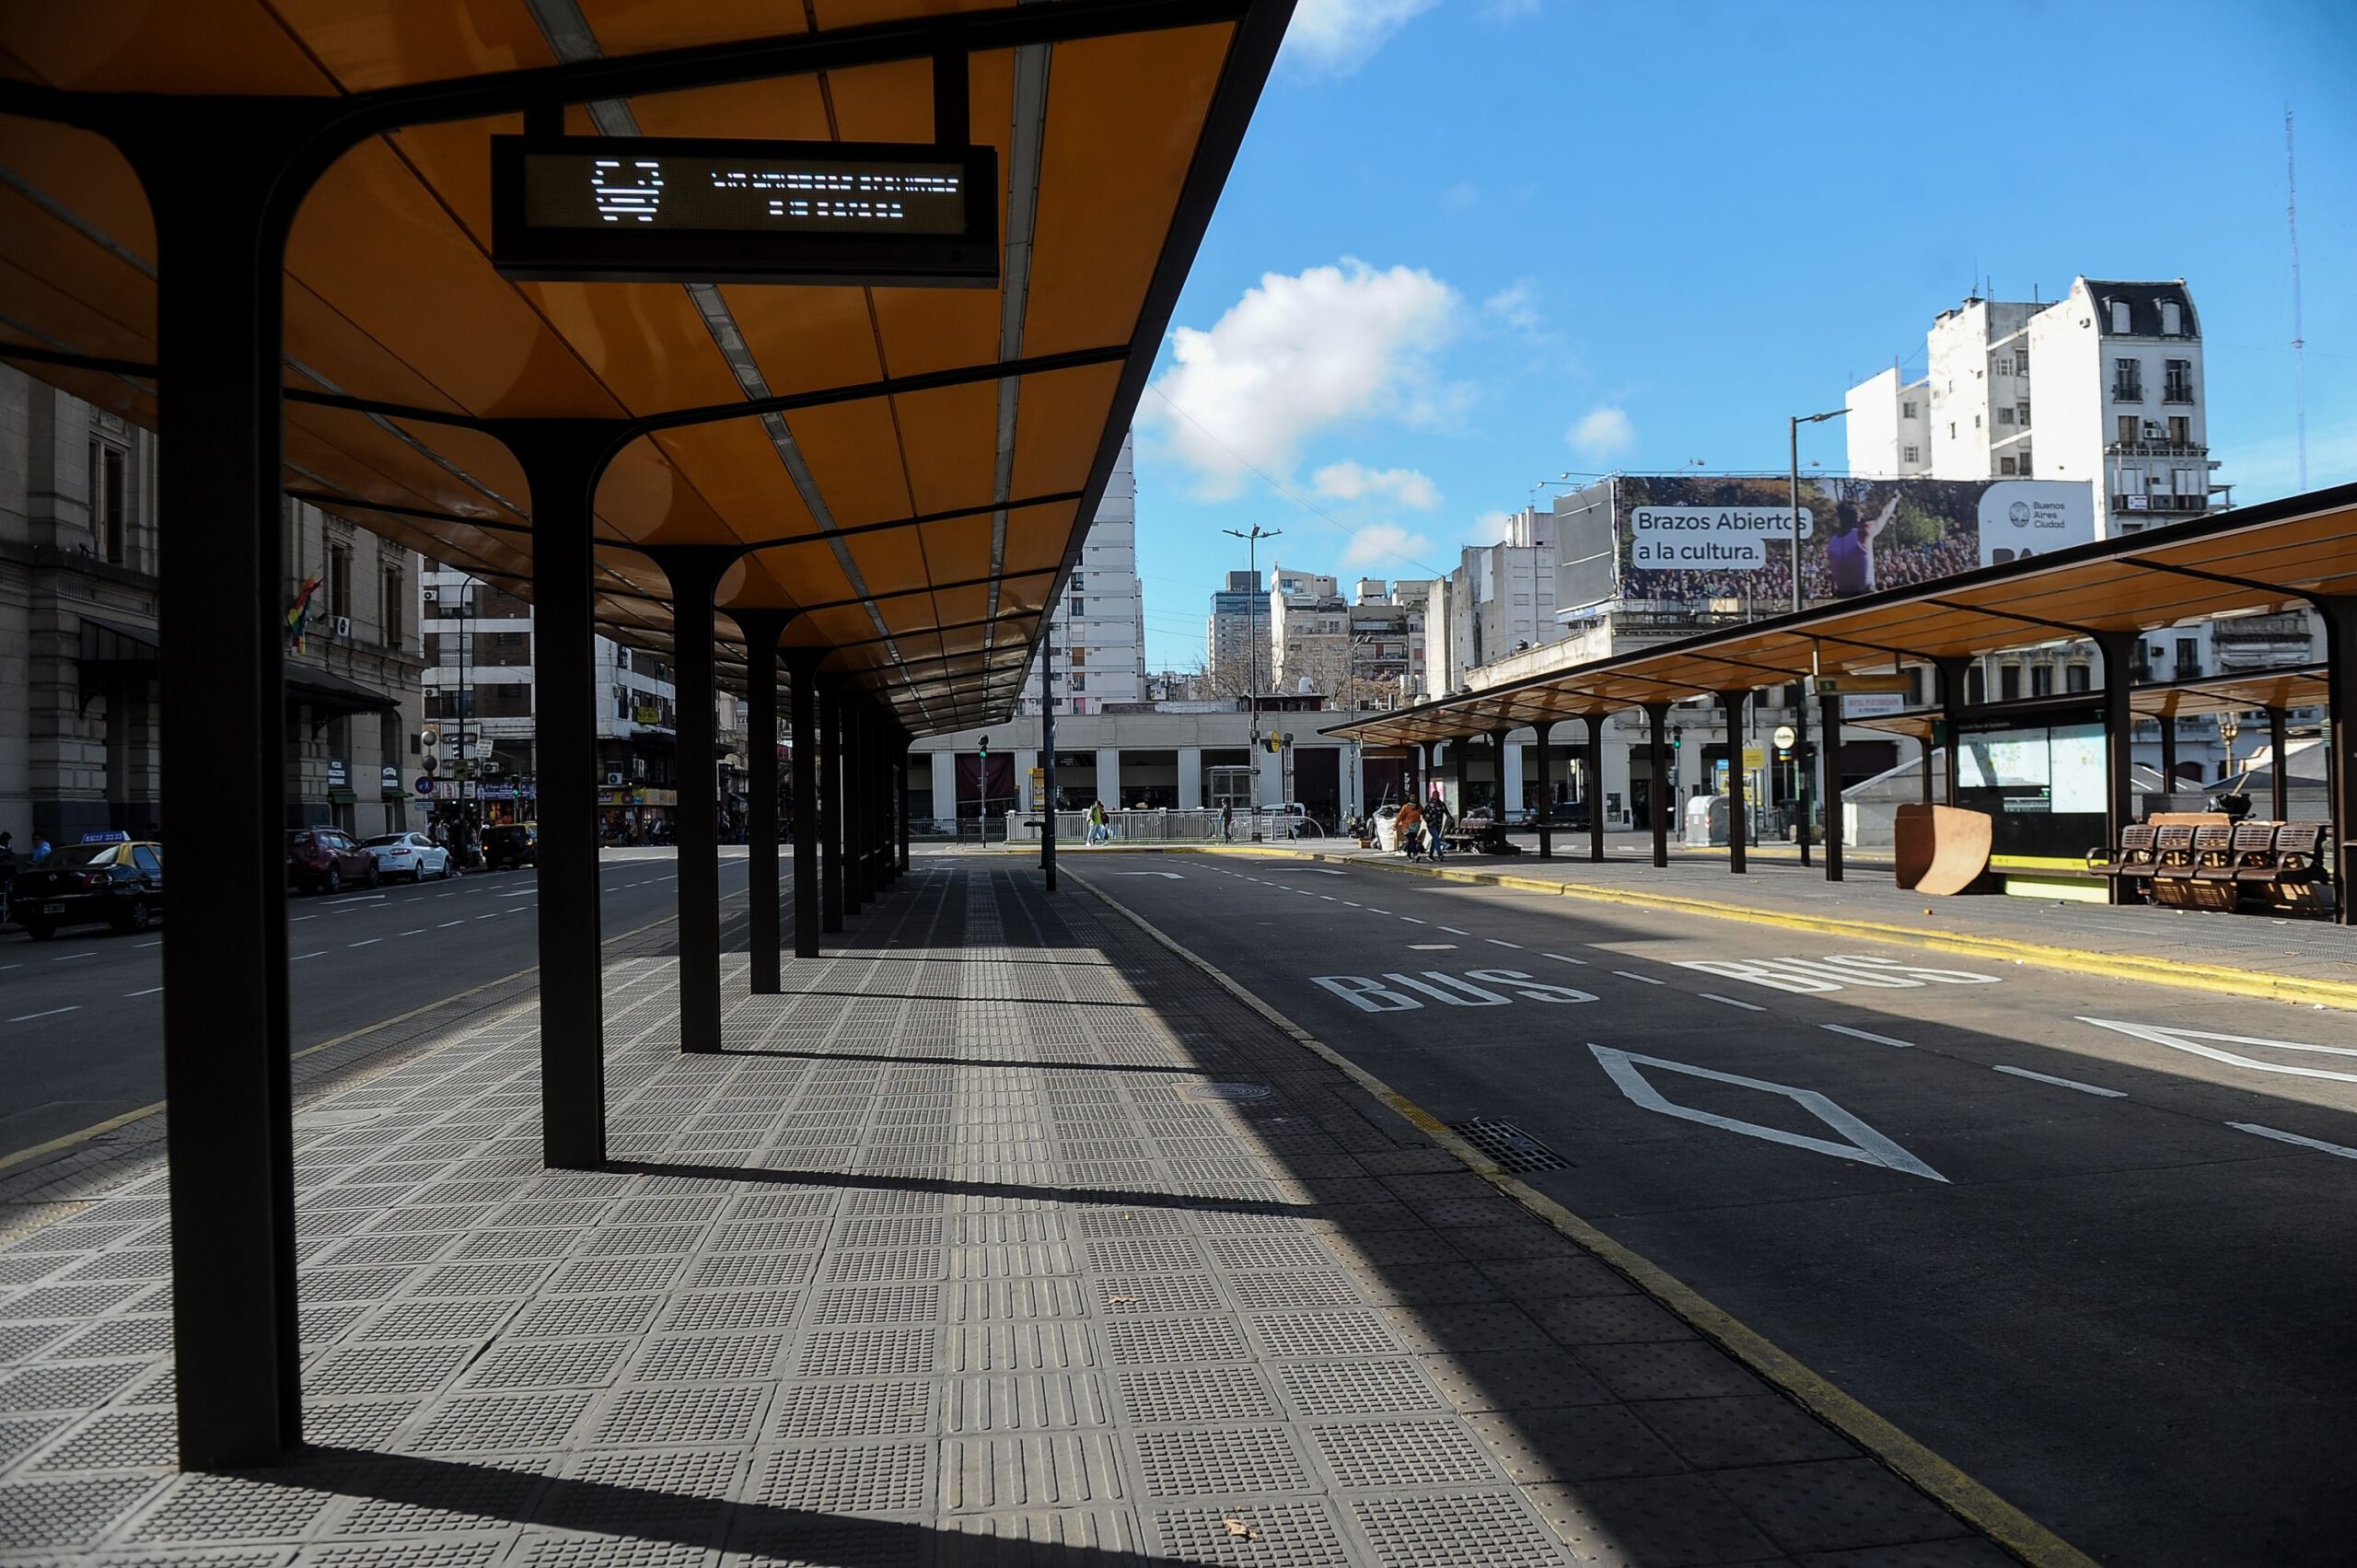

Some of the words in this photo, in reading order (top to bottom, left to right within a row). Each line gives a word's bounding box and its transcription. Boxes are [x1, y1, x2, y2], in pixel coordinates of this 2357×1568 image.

[2033, 501, 2066, 510] Buenos
[1638, 512, 1711, 530] Brazos
[1716, 512, 1807, 530] Abiertos
[2033, 511, 2058, 519] Aires
[2033, 519, 2066, 529] Ciudad
[1638, 546, 1651, 561] a
[1656, 541, 1675, 561] la
[1680, 541, 1759, 561] cultura.
[1670, 954, 2003, 993] BUS
[1309, 969, 1601, 1013] BUS
